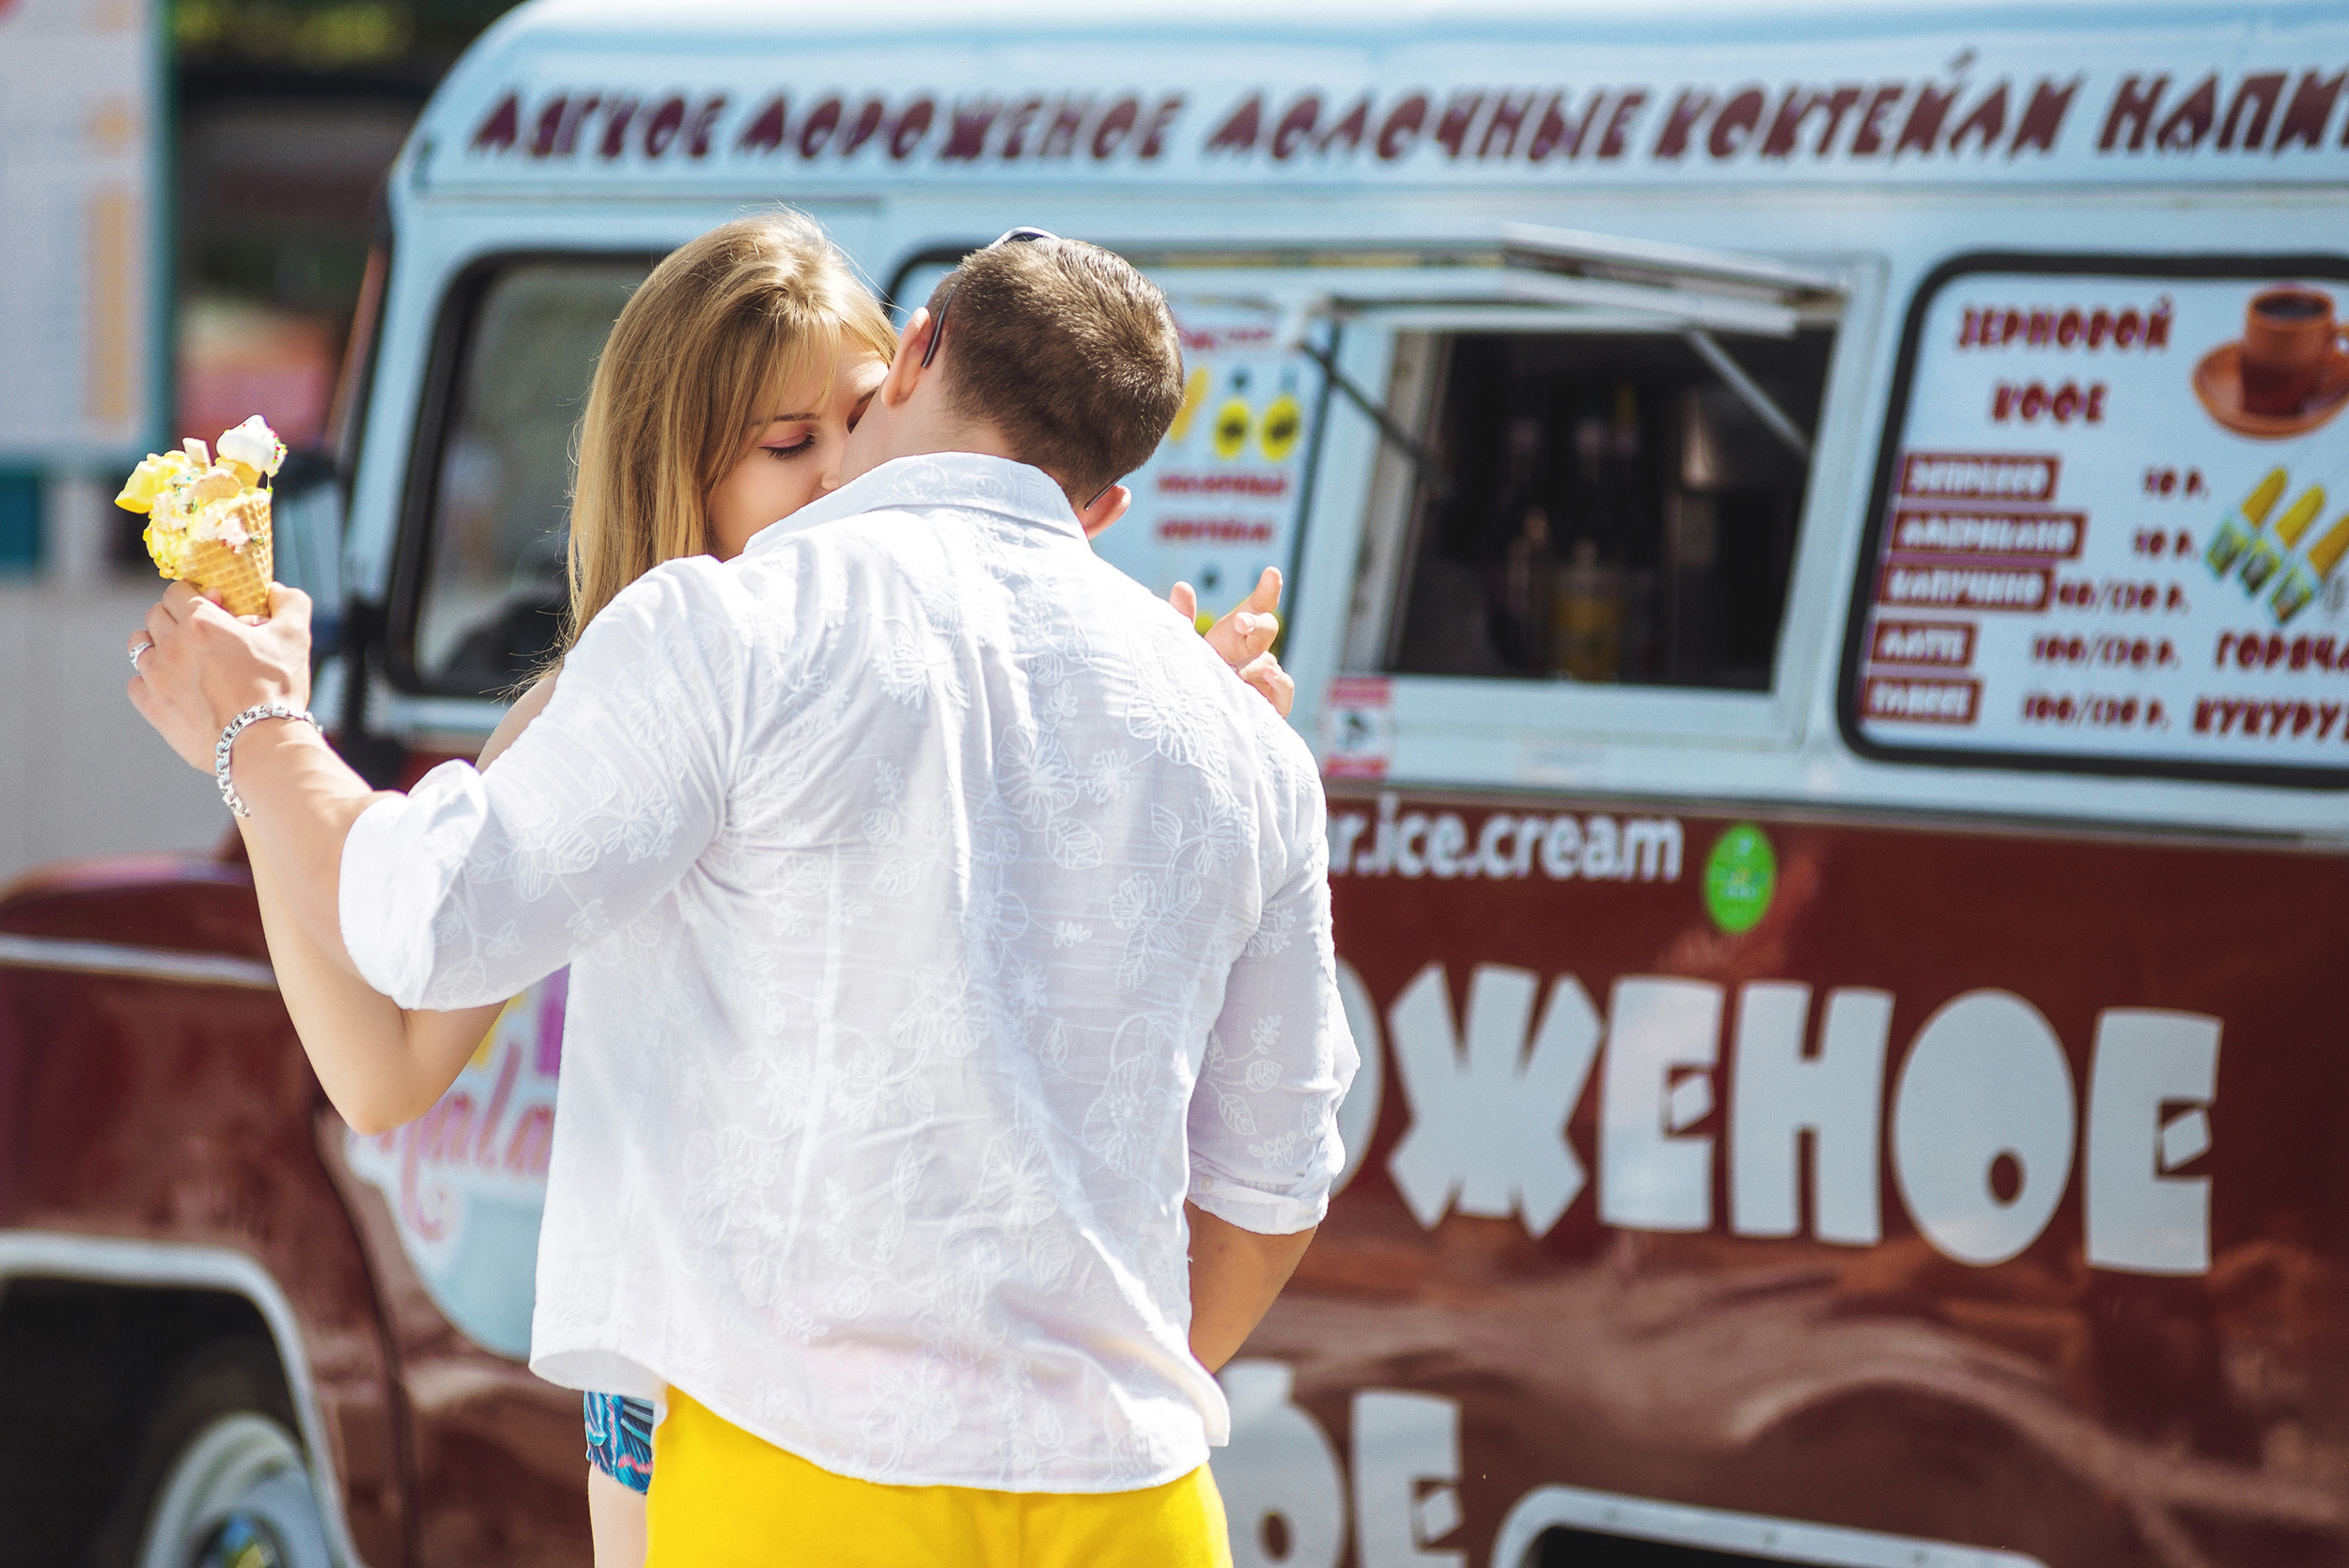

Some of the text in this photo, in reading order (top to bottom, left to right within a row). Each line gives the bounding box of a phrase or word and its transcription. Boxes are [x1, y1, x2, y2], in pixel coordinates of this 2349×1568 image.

[737, 90, 1186, 161] МОРОЖЕНОЕ
[1206, 85, 1650, 162] МОЛОЧНЫЕ
[1652, 47, 2080, 162] КОКТЕЙЛИ
[2095, 66, 2349, 156] НАПИ
[1992, 382, 2106, 424] КОФЕ
[2192, 697, 2349, 741] КУКУРУ
[1327, 792, 1685, 881] r.ice.cream
[1328, 956, 2225, 1278] ЖЕНОЕ
